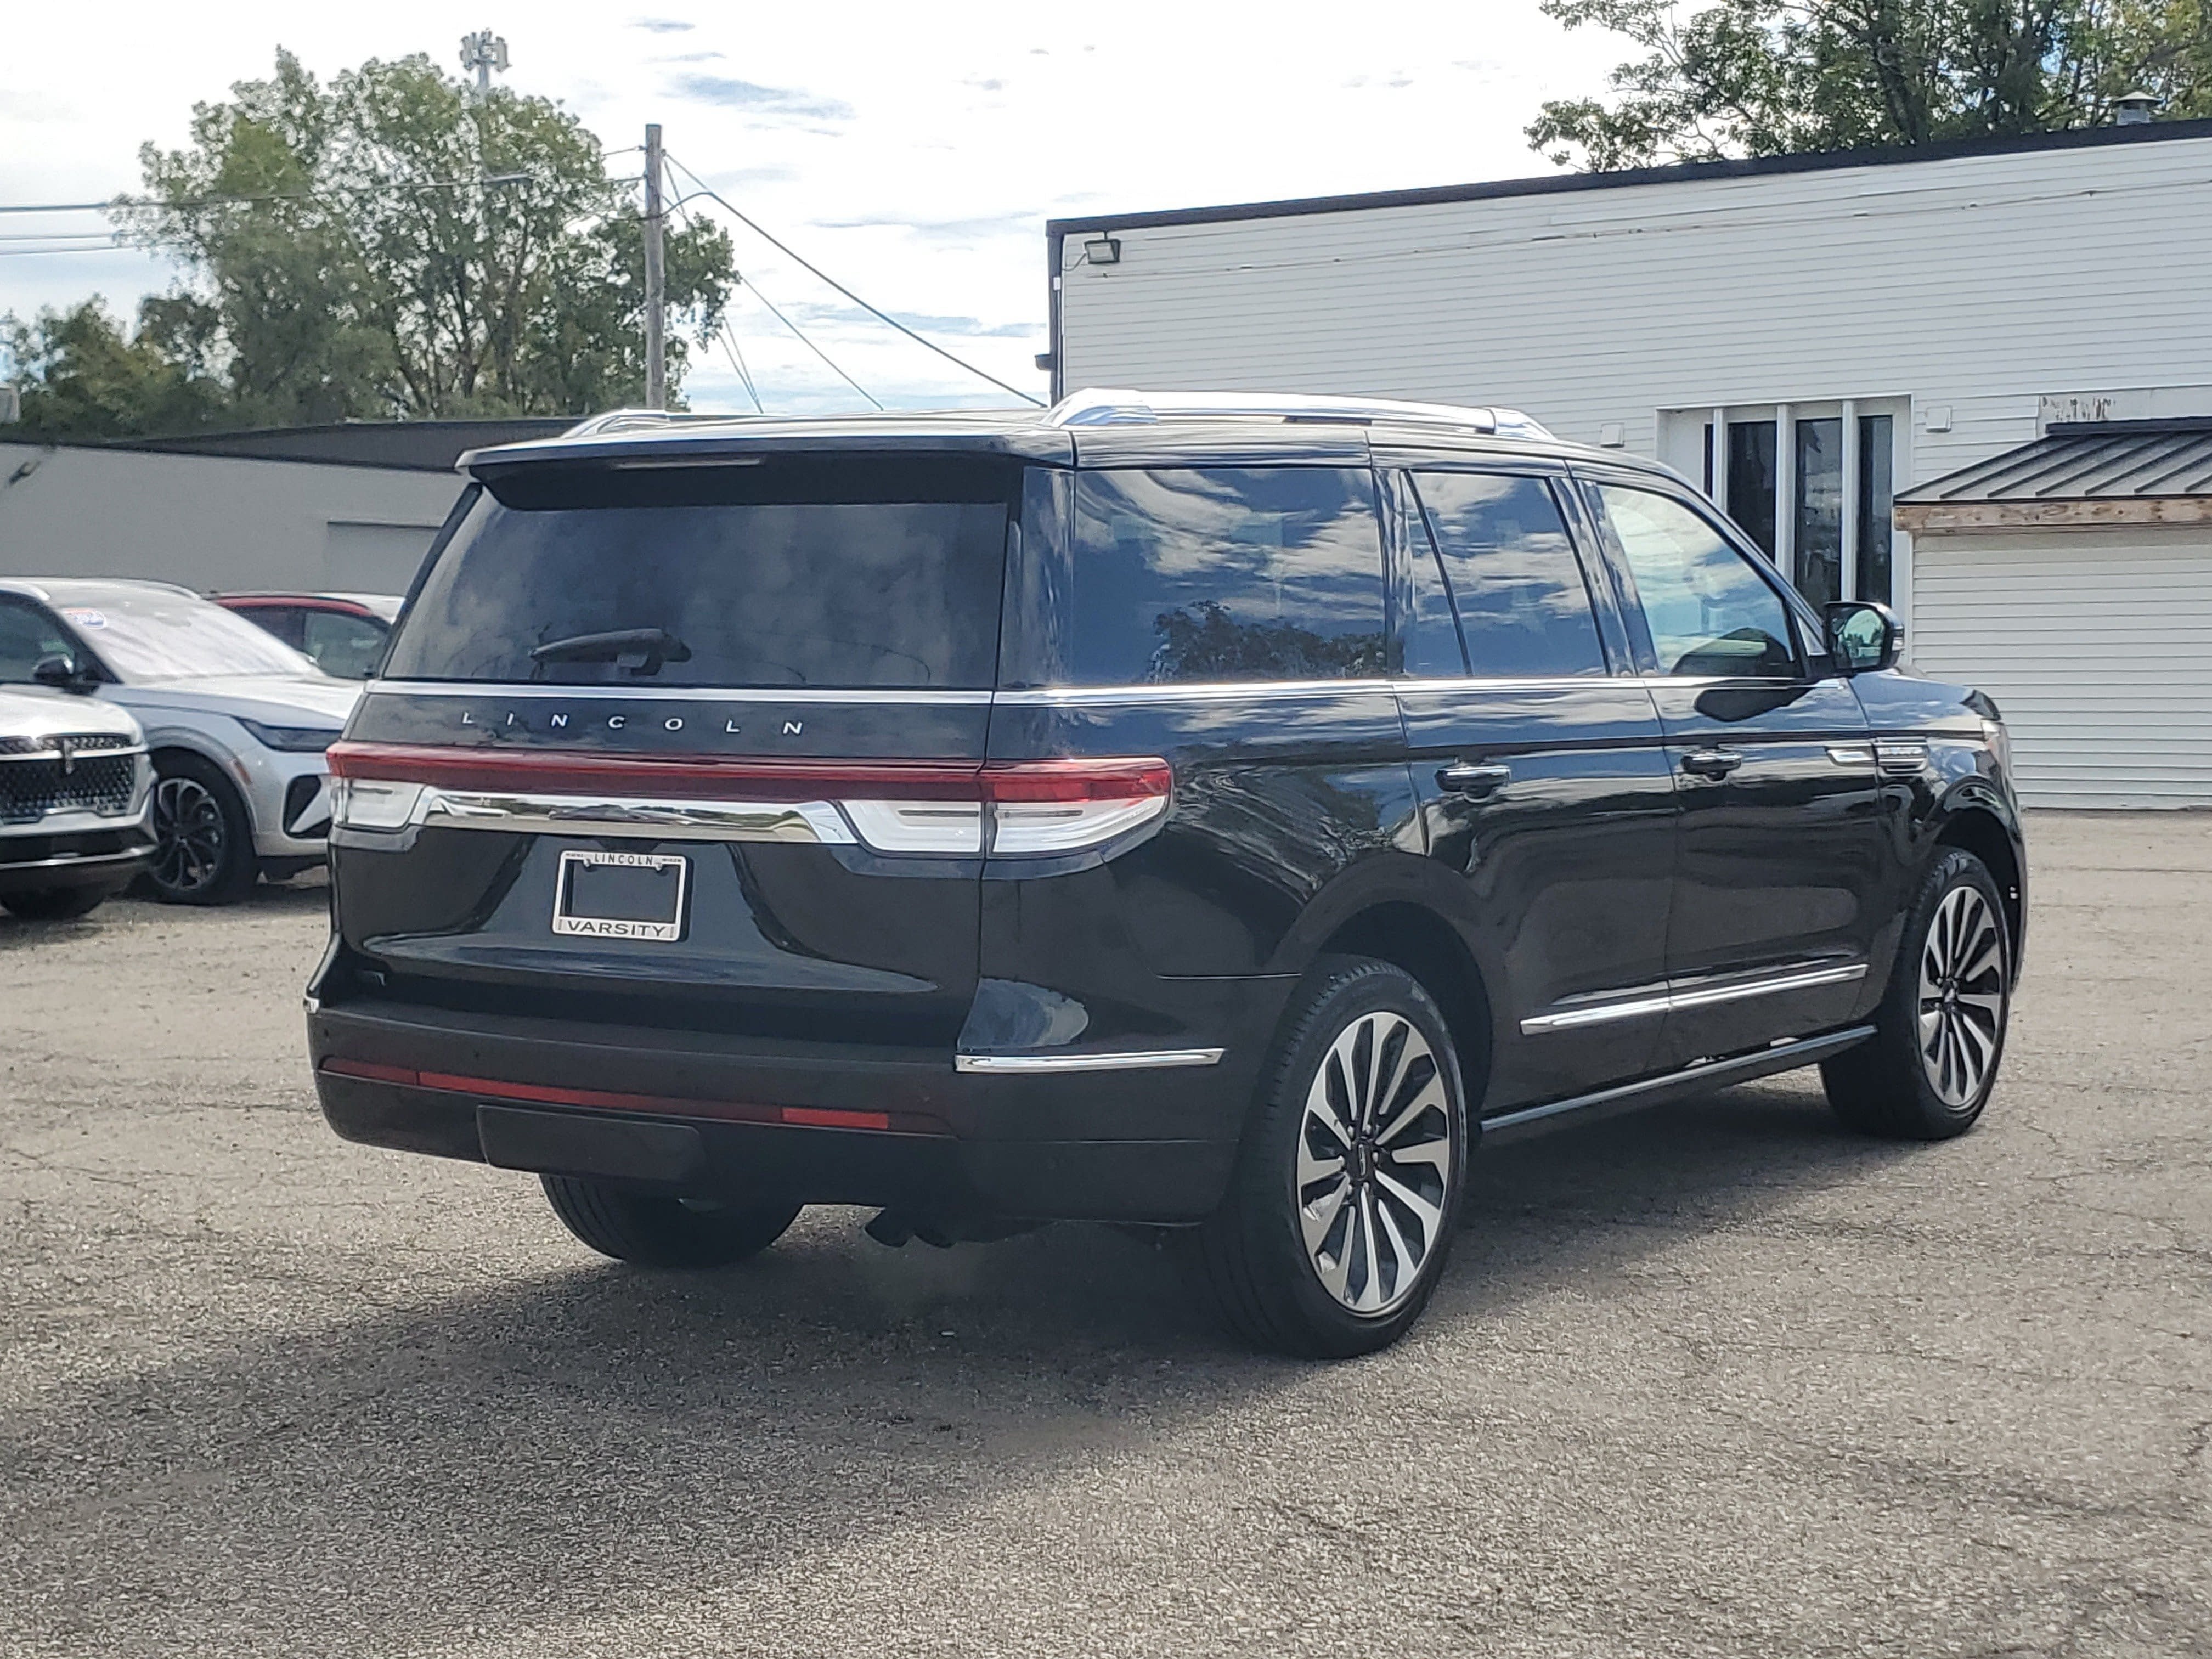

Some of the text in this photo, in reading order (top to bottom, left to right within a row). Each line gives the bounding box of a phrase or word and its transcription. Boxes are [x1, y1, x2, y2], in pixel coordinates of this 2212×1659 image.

[462, 712, 804, 736] LINCOLN
[595, 853, 653, 865] LINCOLN
[568, 920, 666, 937] VARSITY
